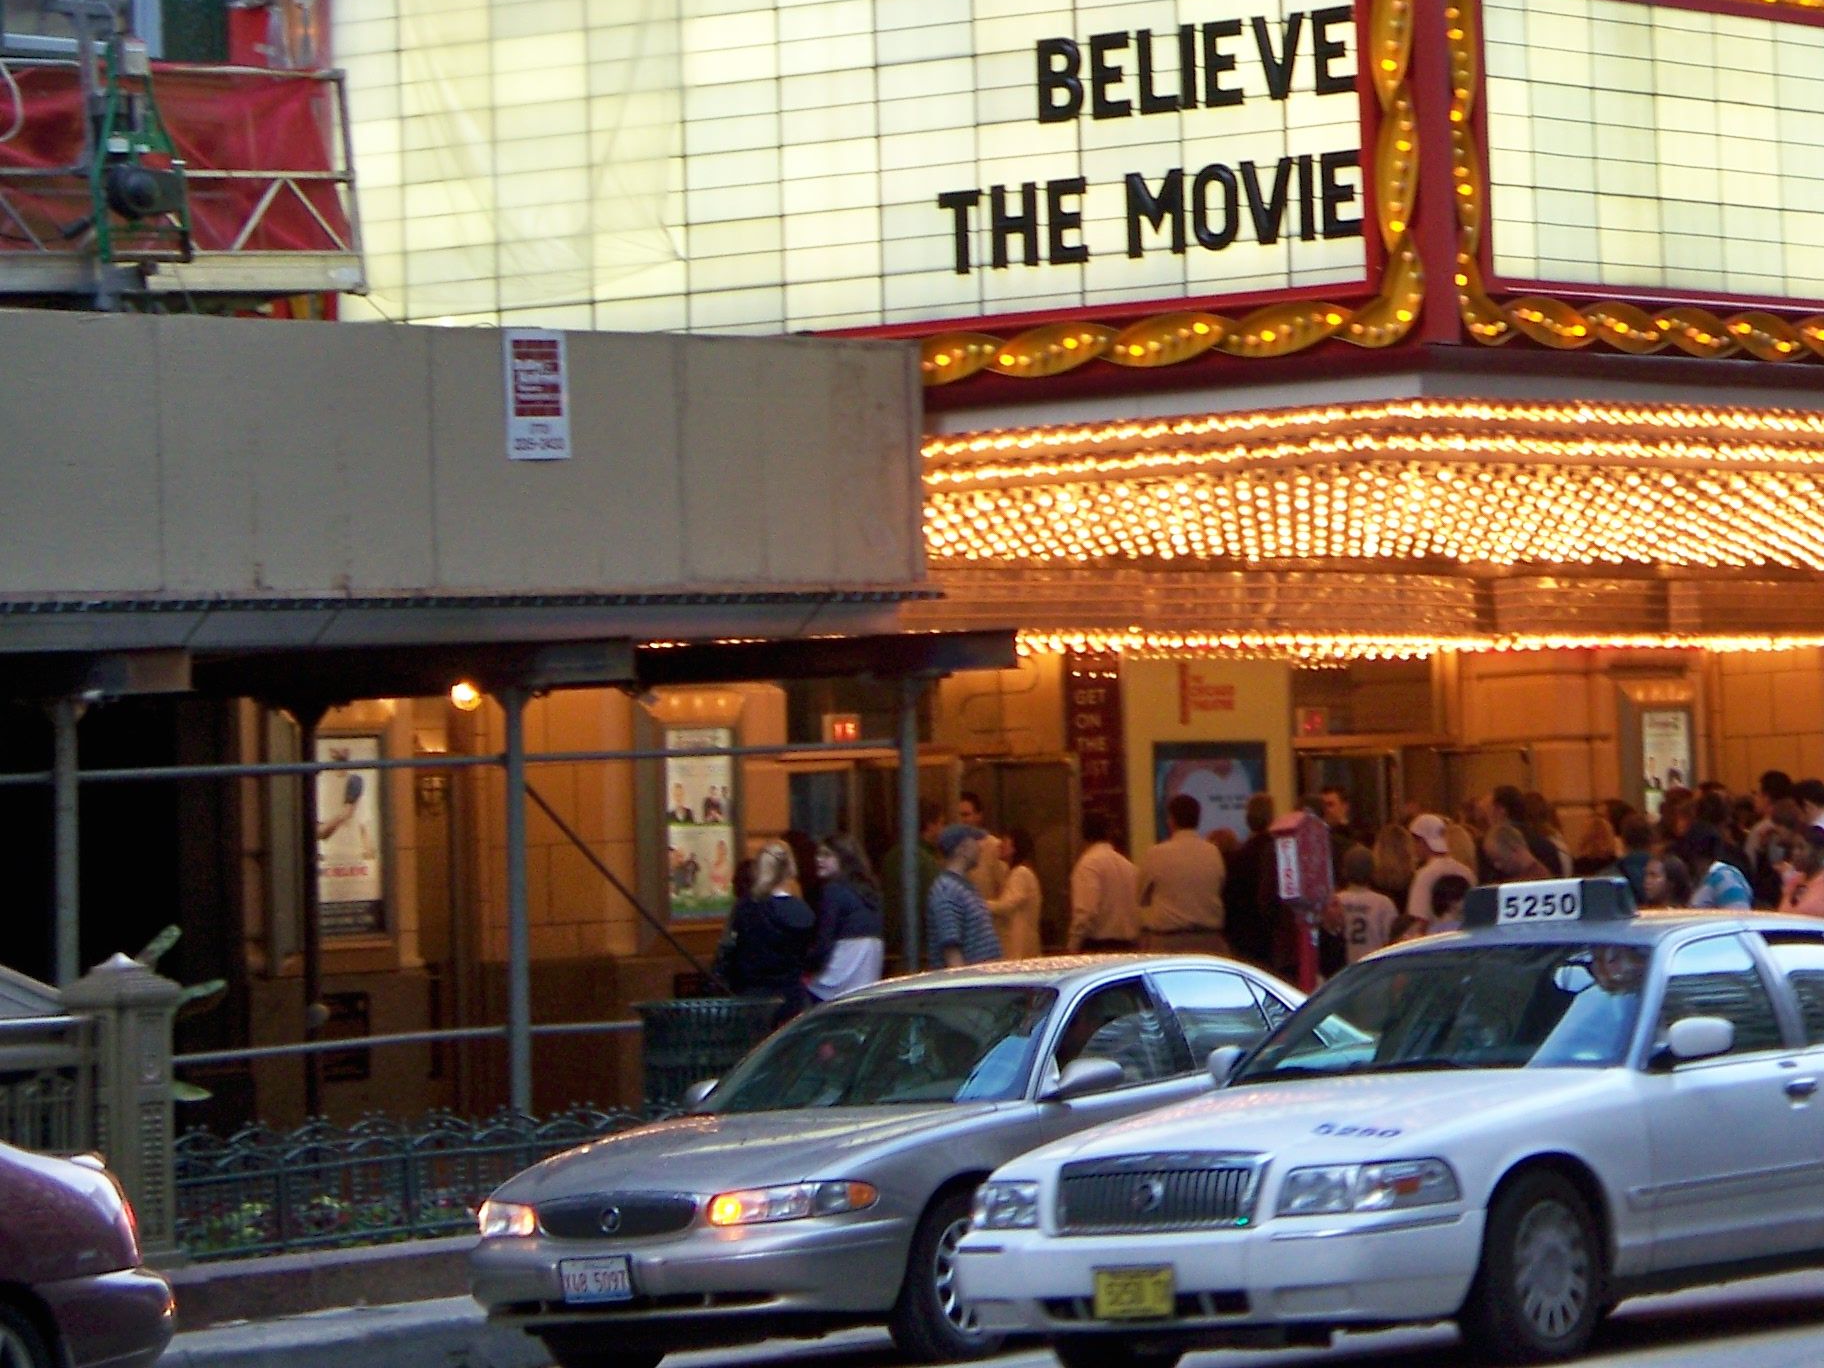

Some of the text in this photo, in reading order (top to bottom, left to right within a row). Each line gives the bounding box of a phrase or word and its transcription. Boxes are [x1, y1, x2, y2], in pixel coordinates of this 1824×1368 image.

[1036, 5, 1358, 124] BELIEVE
[938, 150, 1363, 275] THE MOVIE
[1504, 893, 1576, 919] 5250
